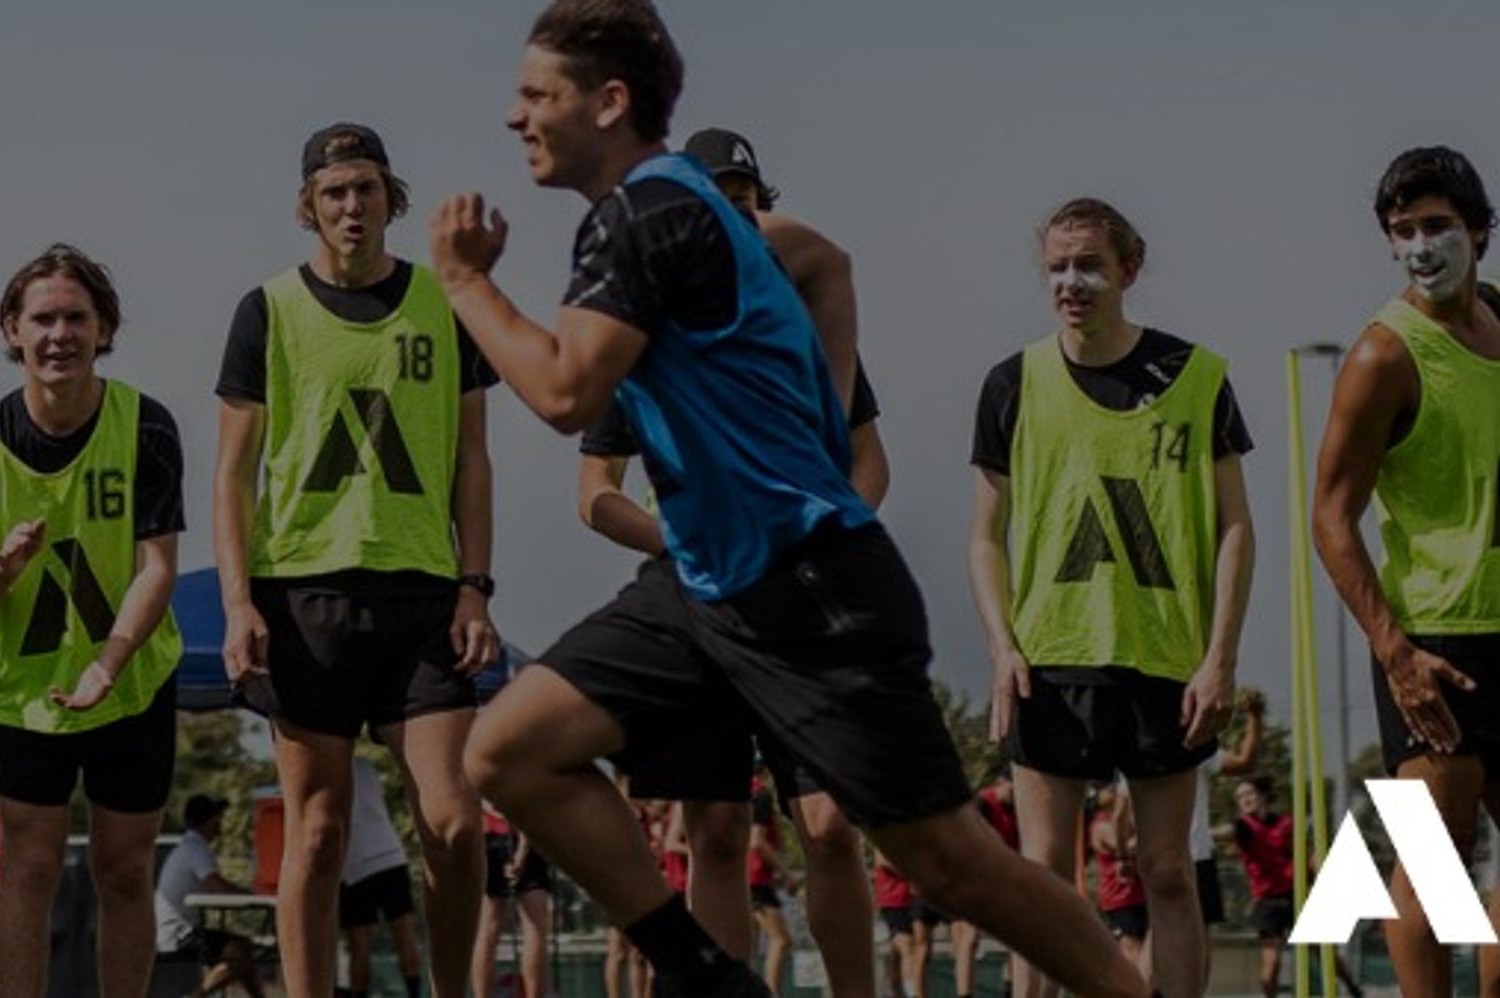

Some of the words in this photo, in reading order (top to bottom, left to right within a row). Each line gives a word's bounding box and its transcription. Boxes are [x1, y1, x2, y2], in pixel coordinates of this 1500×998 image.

[395, 333, 434, 382] 18
[1150, 420, 1191, 473] 14
[84, 469, 125, 520] 16
